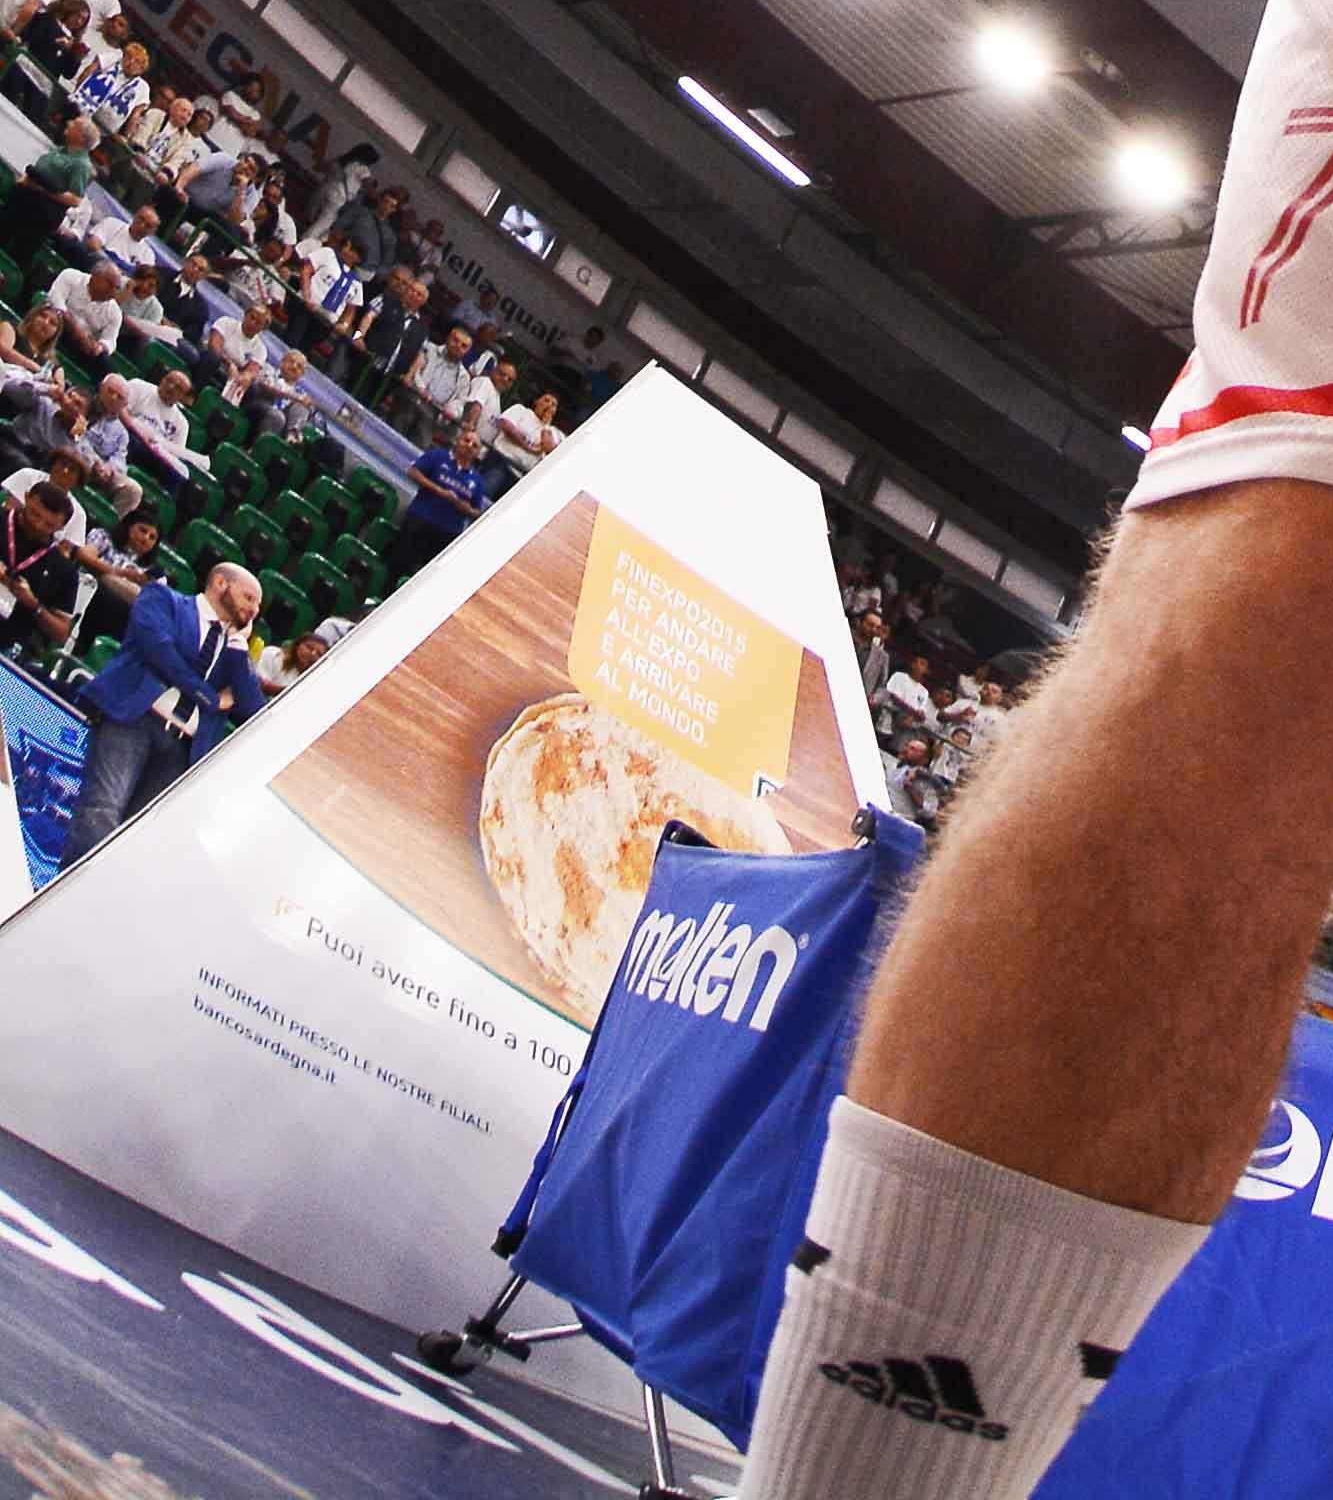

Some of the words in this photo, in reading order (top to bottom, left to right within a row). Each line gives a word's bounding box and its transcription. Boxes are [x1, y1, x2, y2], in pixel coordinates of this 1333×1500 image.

[610, 578, 652, 620] PER
[655, 610, 738, 677] ANDARE
[593, 660, 623, 694] AL
[618, 646, 720, 725] ARRIVARE
[193, 994, 339, 1086] bancosardegna.it
[199, 966, 287, 1028] INFORMATI
[288, 1018, 350, 1063] PRESSO
[353, 1053, 373, 1077] LE
[376, 1065, 436, 1109] NOSTRE
[306, 916, 364, 968] Puoi
[371, 957, 441, 1010] avere
[448, 998, 497, 1039] fino
[503, 1029, 518, 1051] a
[528, 1037, 573, 1078] 100
